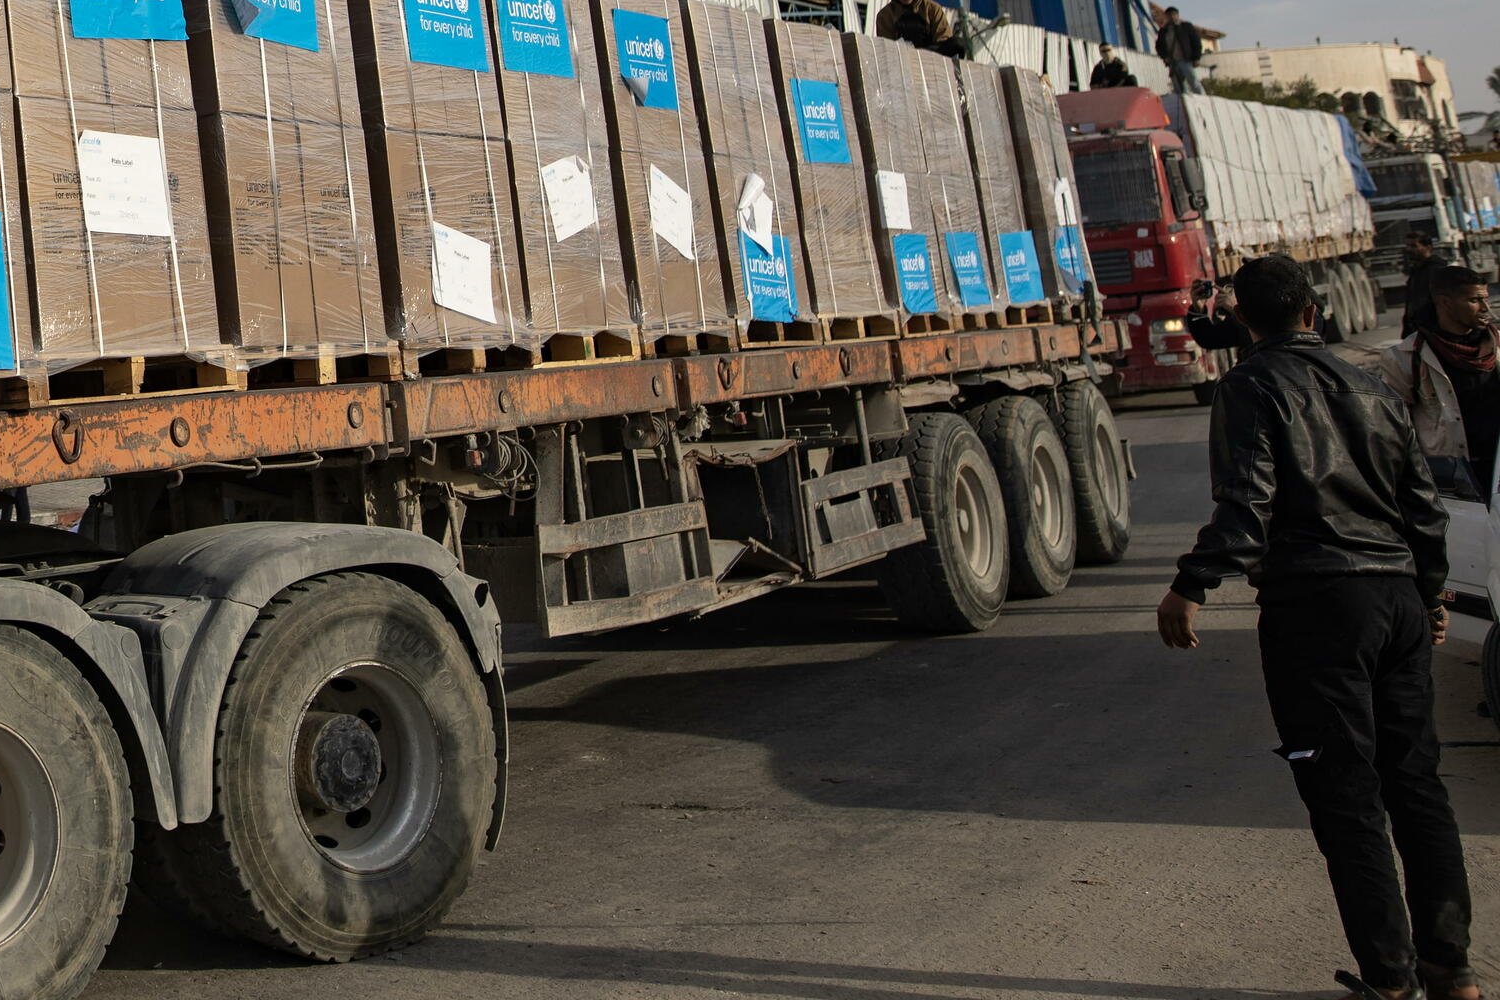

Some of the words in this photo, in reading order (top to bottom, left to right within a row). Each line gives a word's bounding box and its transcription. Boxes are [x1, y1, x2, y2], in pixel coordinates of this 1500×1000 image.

[419, 15, 433, 31] for
[433, 21, 455, 39] every
[455, 23, 474, 39] child
[511, 27, 524, 42] for
[524, 33, 545, 47] every
[545, 34, 561, 48] child
[625, 35, 654, 58] unicef
[630, 64, 639, 79] for
[638, 69, 655, 83] every
[654, 69, 668, 82] child
[802, 100, 827, 120] unicef
[52, 169, 81, 184] unice
[748, 253, 776, 276] unicef
